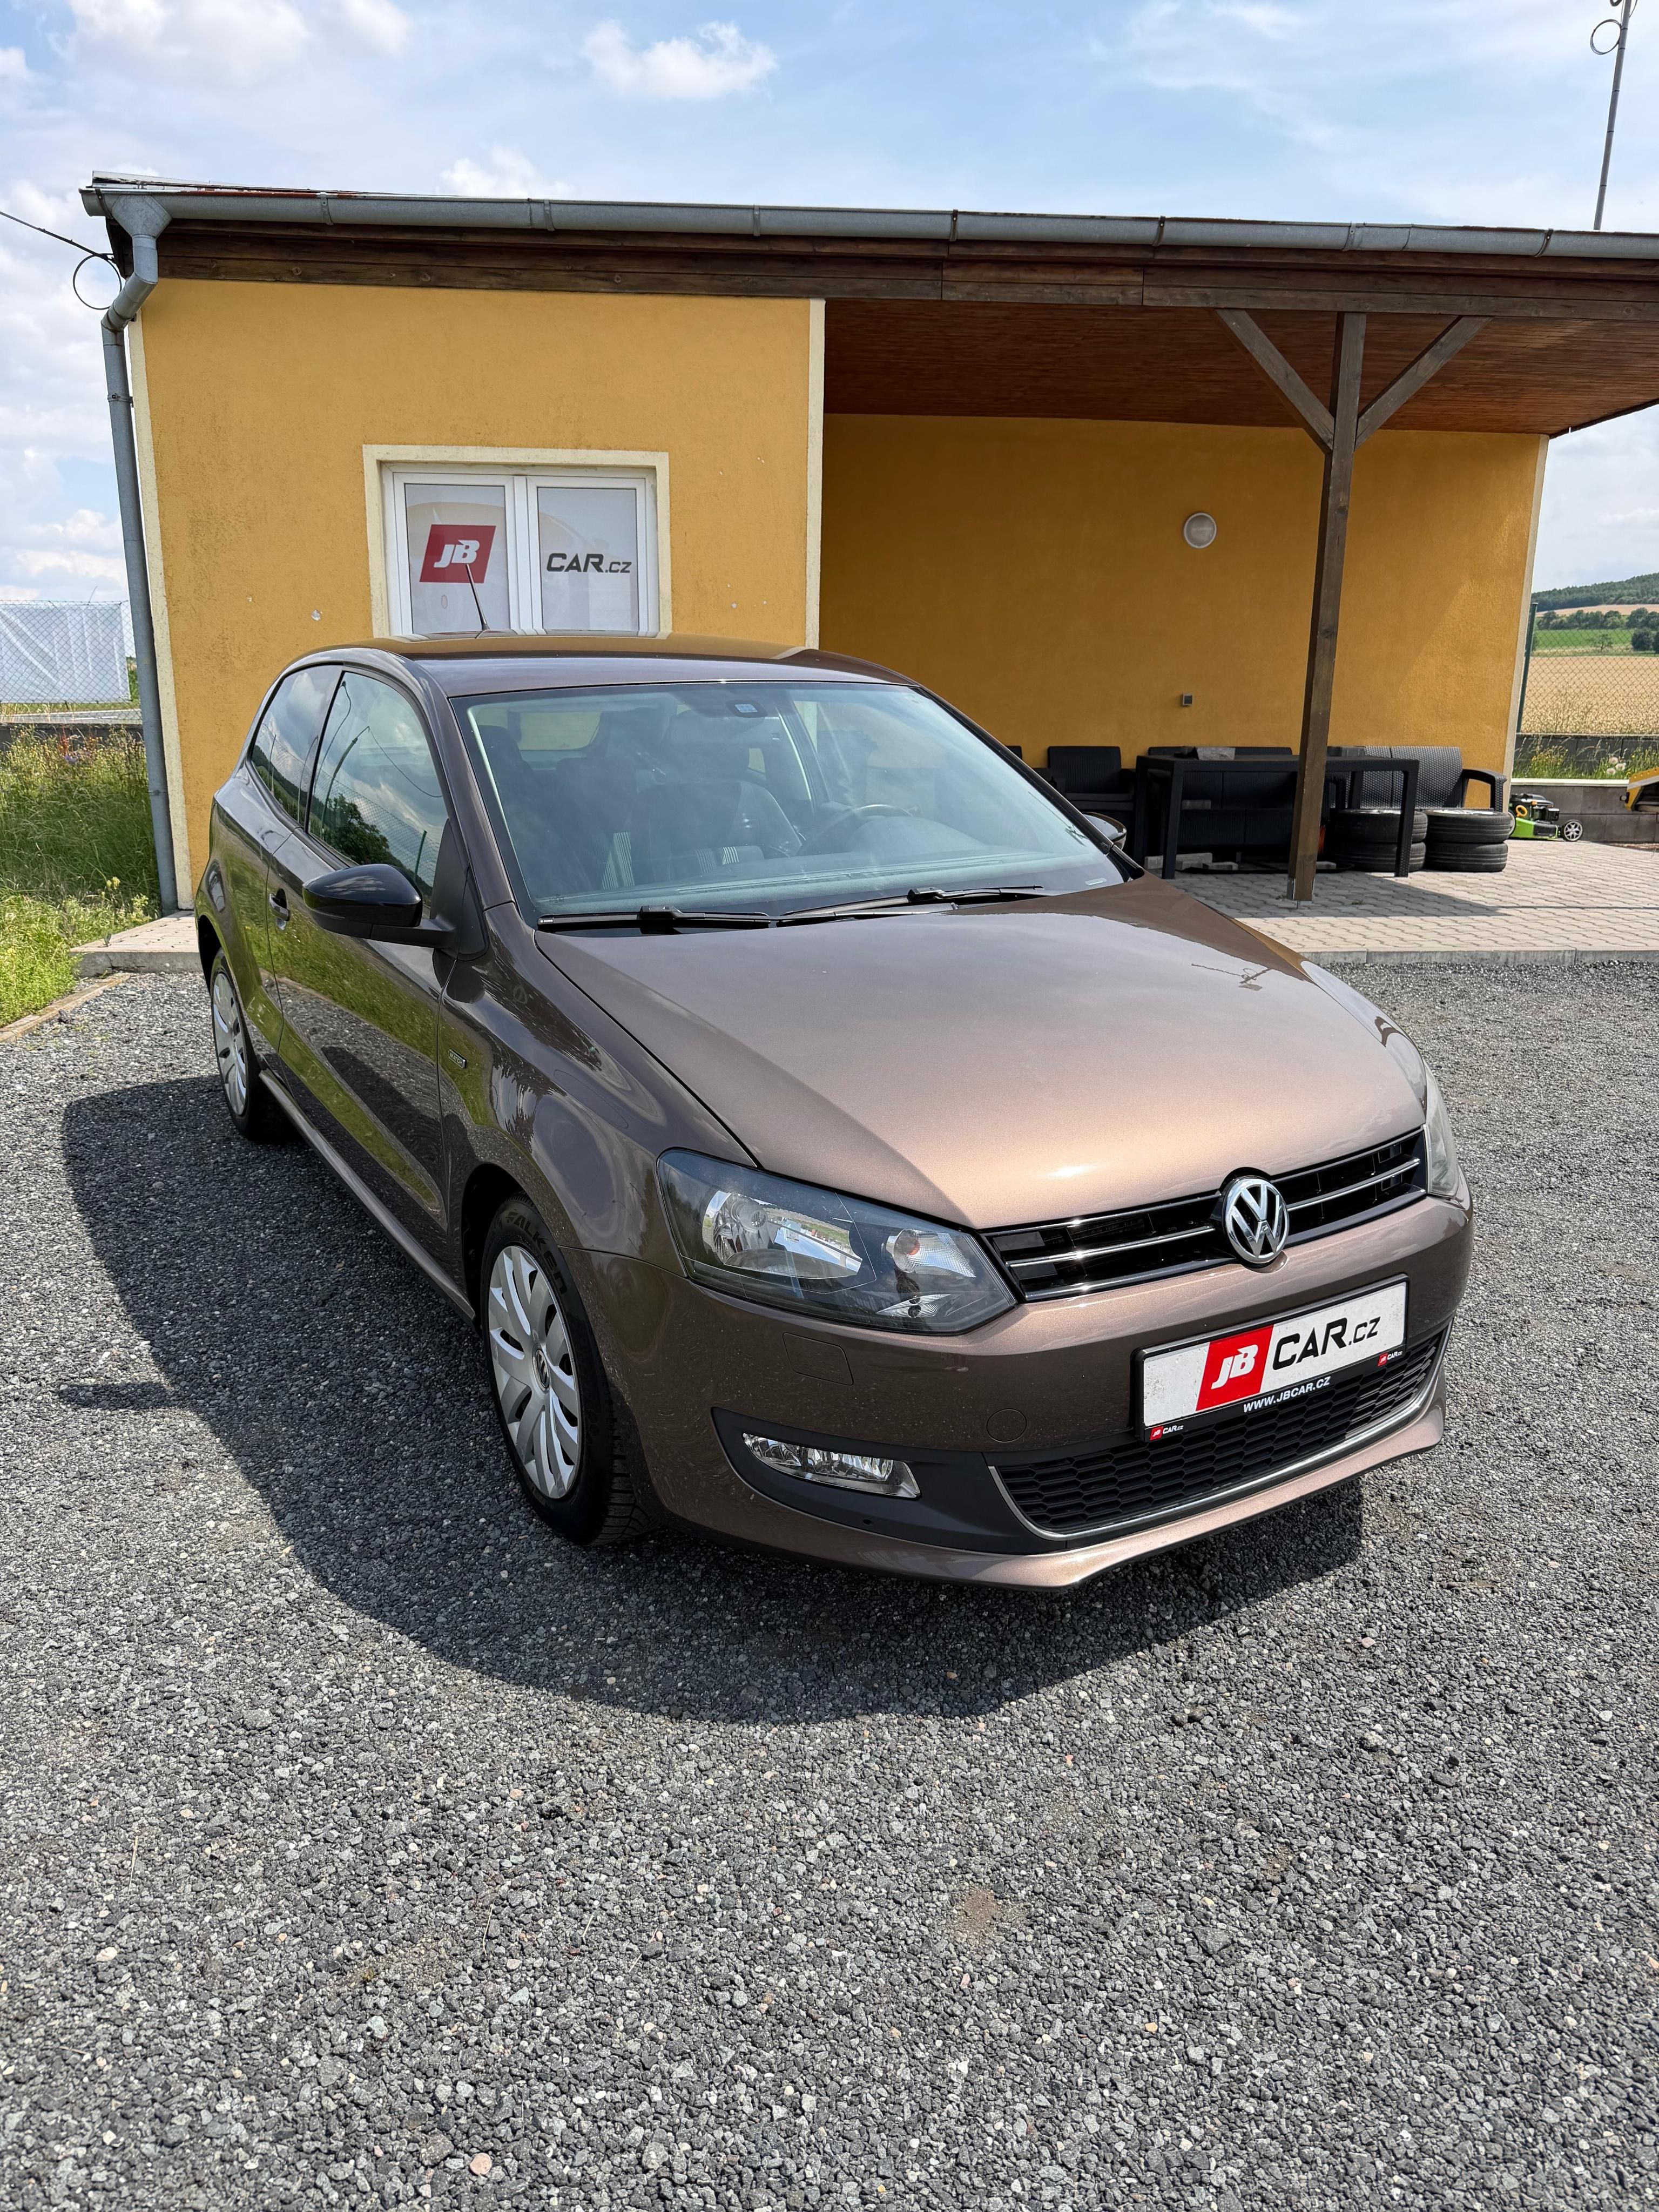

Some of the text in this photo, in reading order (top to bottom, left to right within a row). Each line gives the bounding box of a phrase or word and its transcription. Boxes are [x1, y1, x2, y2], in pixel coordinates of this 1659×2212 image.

[434, 539, 480, 568] JB
[1224, 1175, 1289, 1263] VW
[1211, 1344, 1259, 1390] JB
[1243, 1376, 1331, 1413] WWW.JBCAR.CZ
